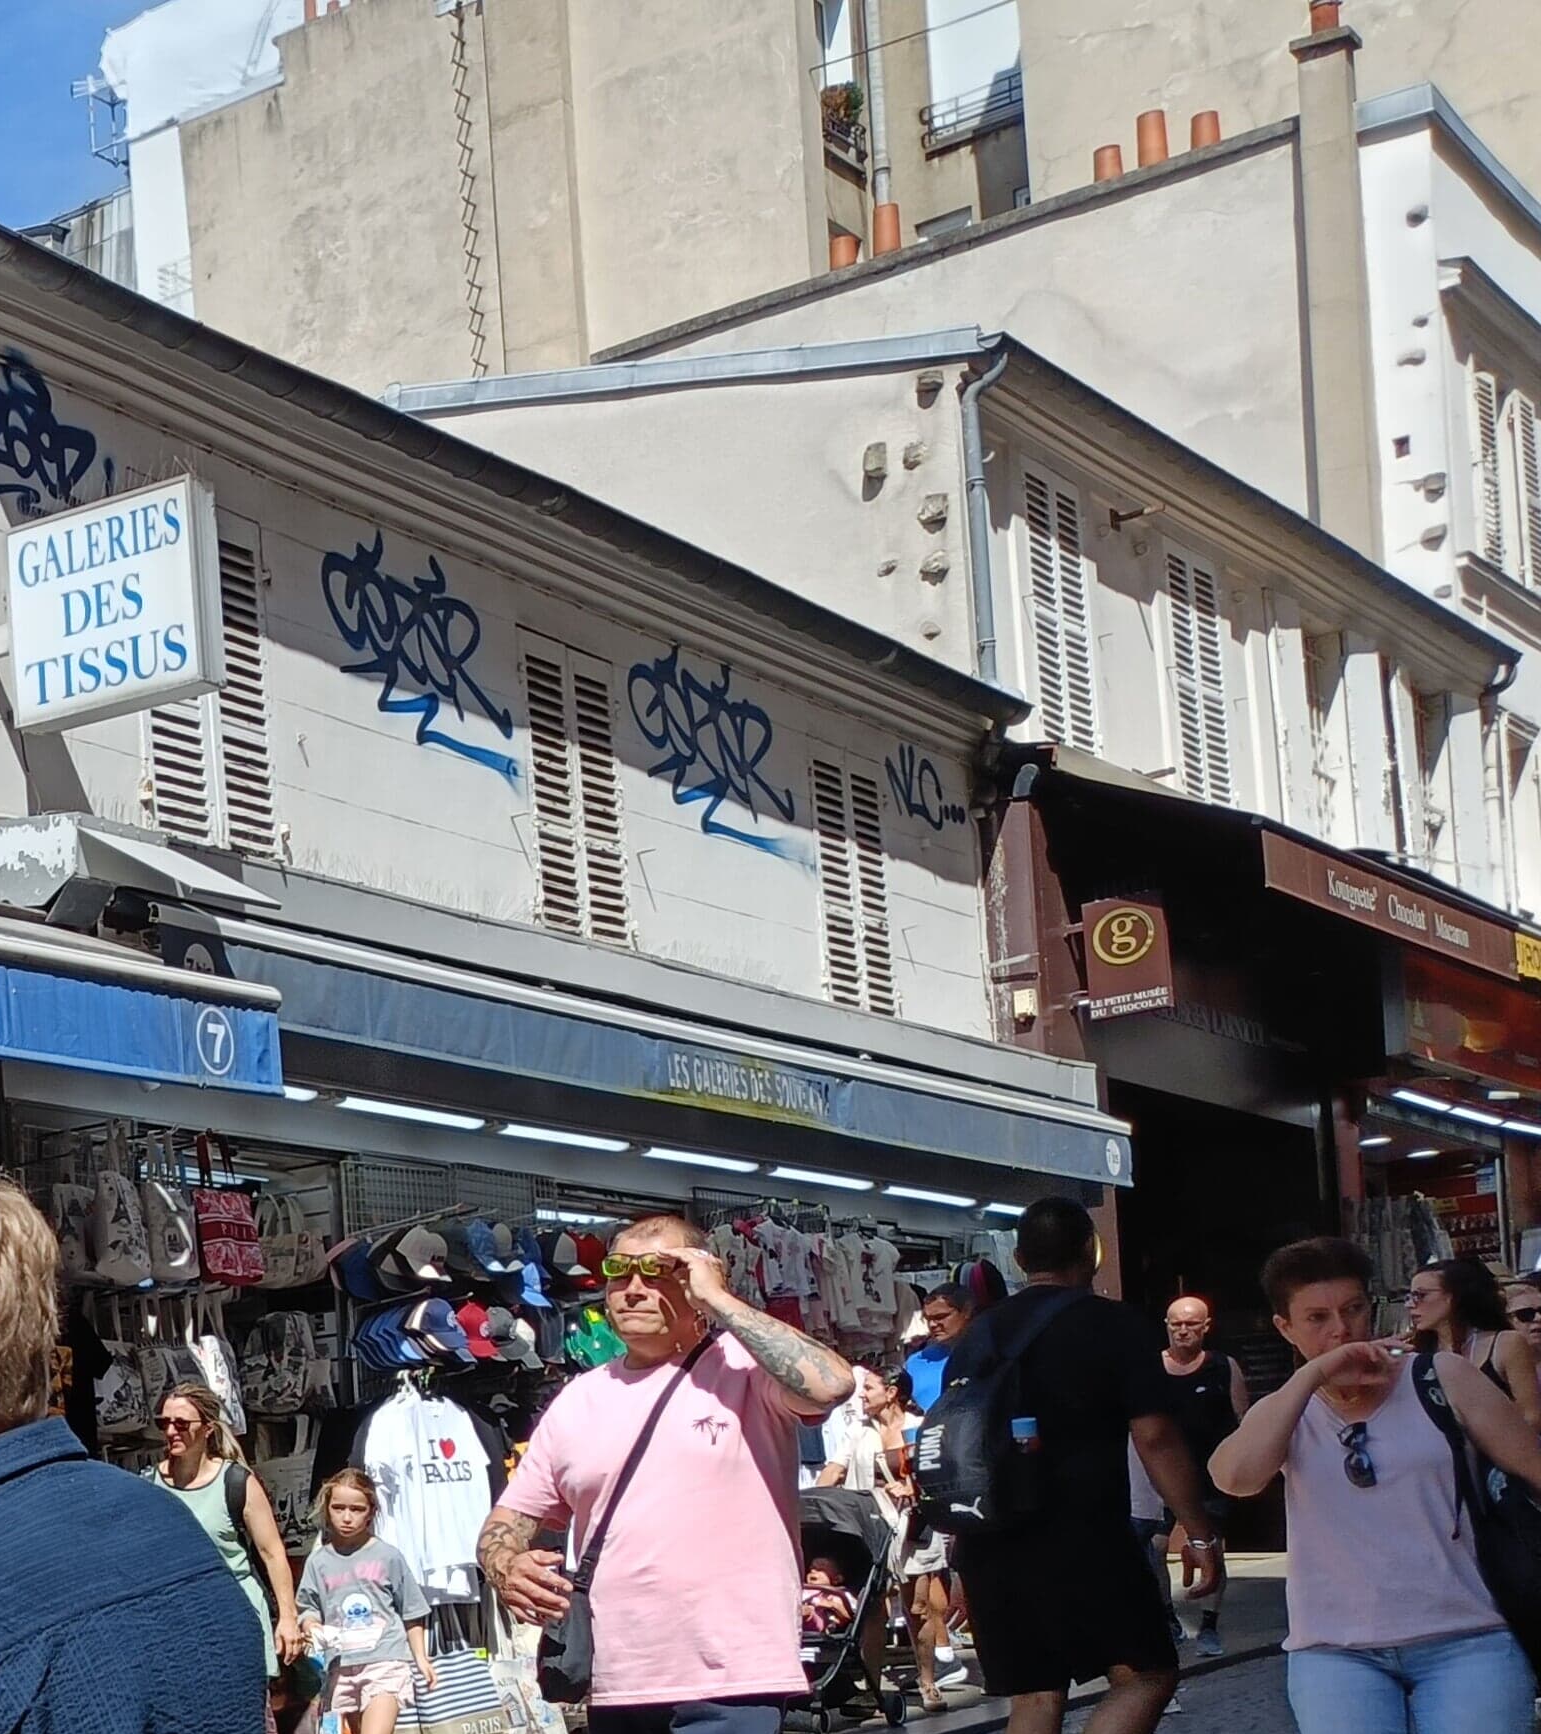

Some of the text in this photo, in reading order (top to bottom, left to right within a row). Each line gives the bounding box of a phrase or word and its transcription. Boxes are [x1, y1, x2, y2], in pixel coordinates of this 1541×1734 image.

[17, 498, 181, 588] GALERIES
[60, 572, 144, 638] DES
[24, 623, 189, 706] TISSUS
[1388, 893, 1427, 931] Chocolat
[1434, 911, 1470, 948] Macaron
[1090, 985, 1169, 1009] LE PETIT MUSÉE
[1091, 997, 1169, 1019] DU CHOCOLAT
[206, 1022, 226, 1064] 7
[667, 1052, 691, 1091] LES
[692, 1057, 749, 1101] GALERIES
[750, 1067, 772, 1105] DES
[428, 1439, 439, 1460] I
[918, 1423, 945, 1471] PUMA
[421, 1460, 473, 1484] PARIS
